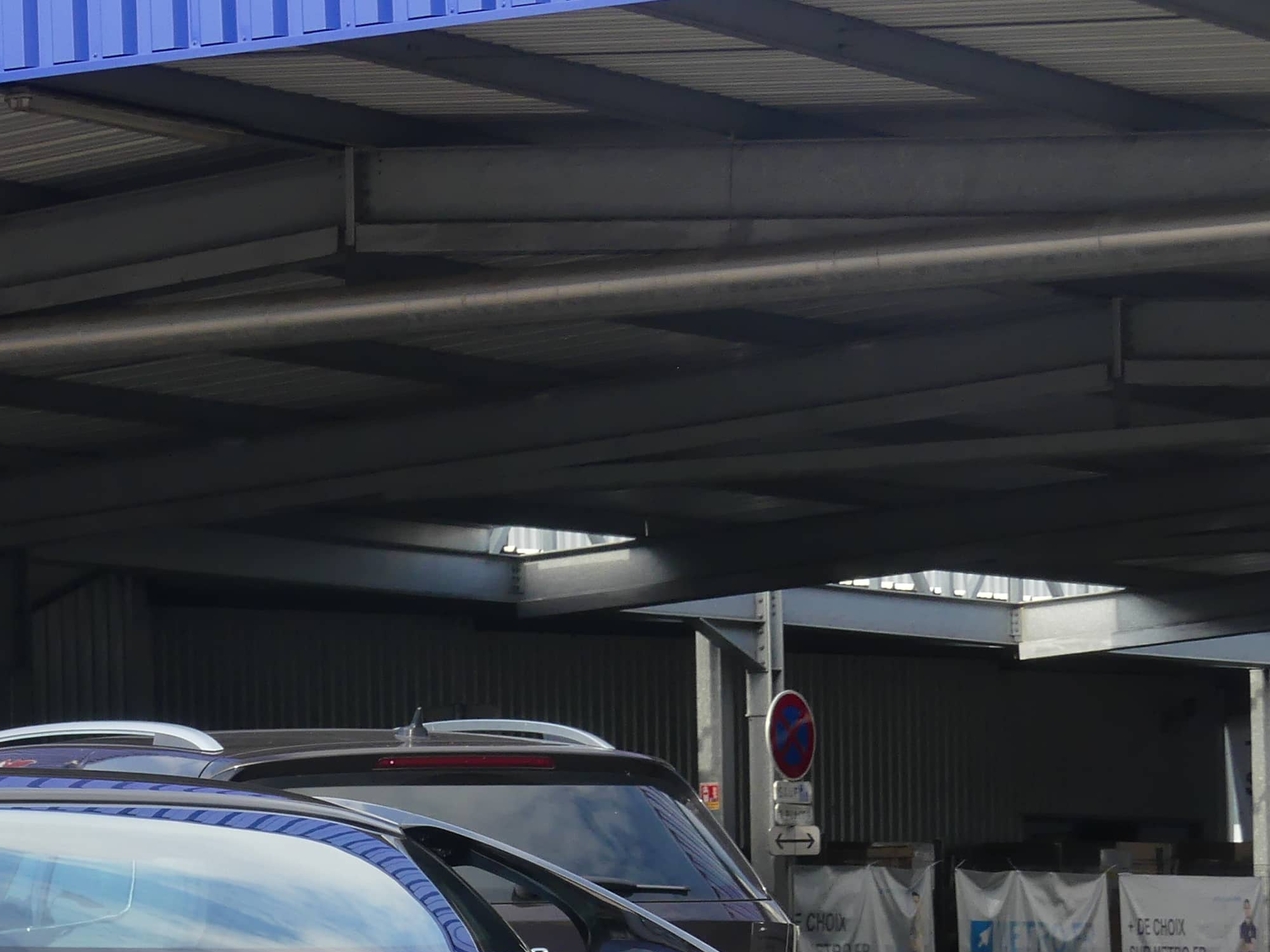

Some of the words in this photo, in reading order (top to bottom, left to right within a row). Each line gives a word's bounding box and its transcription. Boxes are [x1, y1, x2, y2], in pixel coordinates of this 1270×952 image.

[806, 912, 847, 932] CHOIX
[1137, 918, 1151, 936] DE
[1153, 918, 1186, 936] CHOIX
